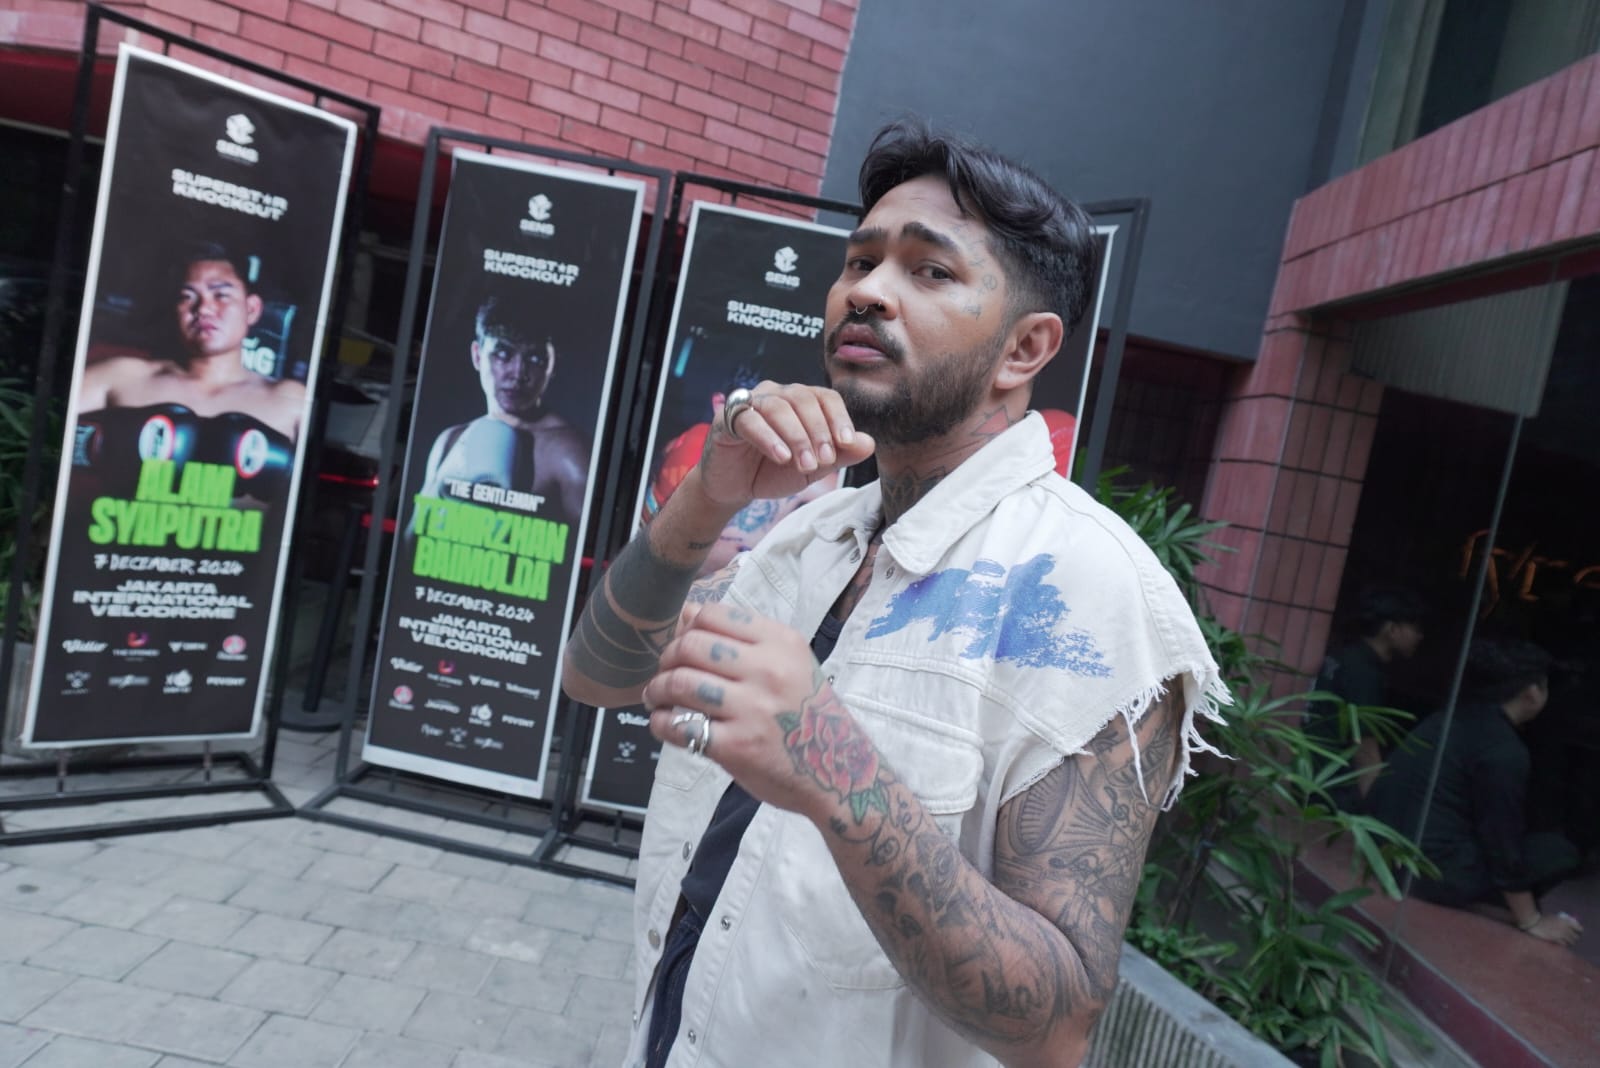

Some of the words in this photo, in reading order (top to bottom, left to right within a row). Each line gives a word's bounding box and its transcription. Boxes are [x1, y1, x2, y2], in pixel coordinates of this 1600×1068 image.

[172, 181, 285, 221] KNOCKOUT
[483, 260, 577, 287] KNOCKOUT
[765, 271, 800, 288] SENS
[727, 311, 821, 339] KNOCKOUT
[88, 496, 262, 552] SYAPUTRA
[93, 554, 109, 569] 7
[110, 554, 195, 576] DECEMBER
[197, 558, 244, 576] 2024
[72, 590, 253, 609] INTERNATIONAL
[117, 579, 217, 595] JAKARTA
[90, 605, 236, 620] VELODROME
[415, 586, 426, 600] 7
[426, 588, 494, 616] DECEMBER
[495, 603, 536, 623] 2024
[398, 616, 542, 657] INTERNATIONAL
[431, 612, 512, 639] JAKARTA
[410, 631, 528, 665] VELODROME
